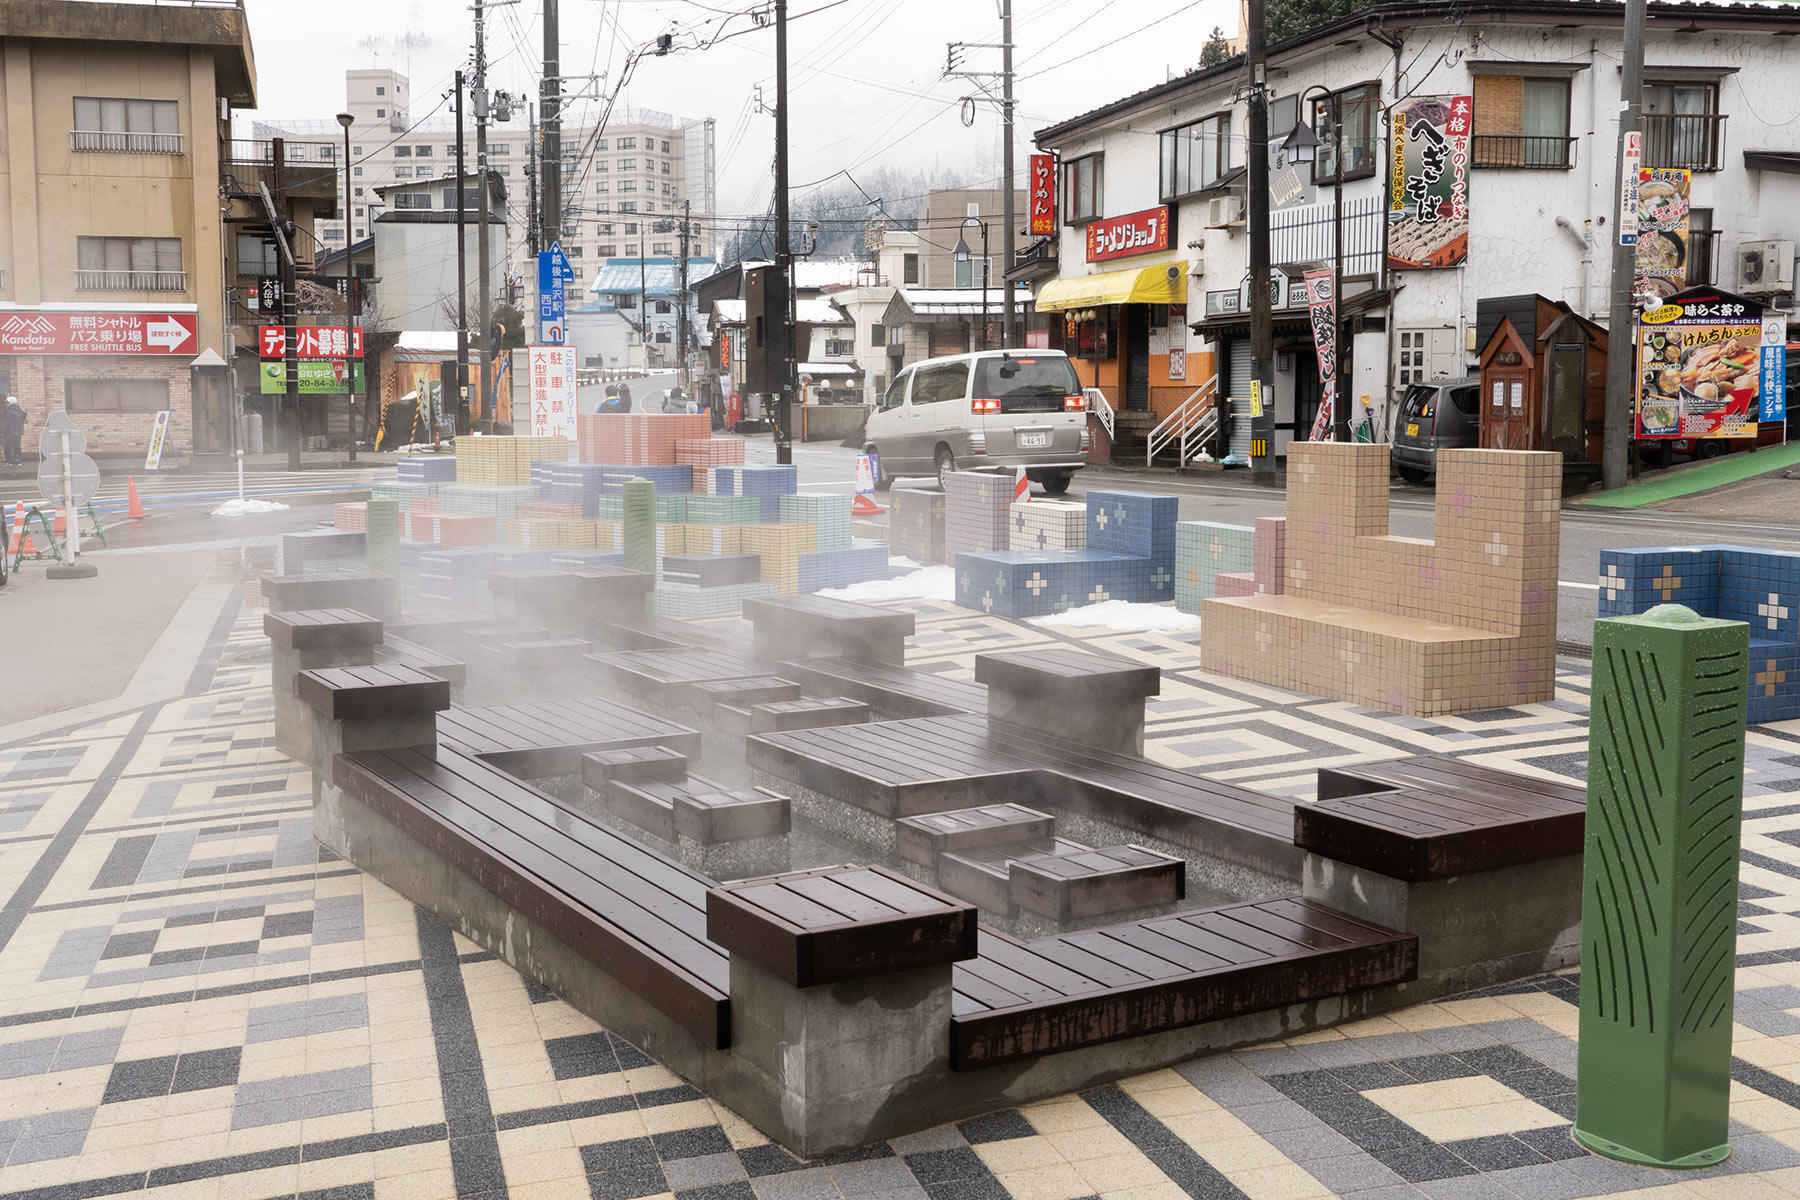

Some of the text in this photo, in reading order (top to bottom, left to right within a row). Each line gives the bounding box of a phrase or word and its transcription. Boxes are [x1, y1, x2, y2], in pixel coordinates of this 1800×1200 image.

[1448, 100, 1469, 133] 本格
[1034, 158, 1050, 216] らーめん
[1406, 117, 1450, 223] へぎそば
[1451, 136, 1468, 221] 布のりつなぎ
[1033, 218, 1052, 233] 餃子
[1096, 217, 1158, 255] ラーメンショップ
[1160, 209, 1168, 248] うまい
[551, 254, 563, 312] 越後湯沢駅
[69, 316, 142, 329] 無料シャトル
[541, 294, 552, 317] 西口
[1684, 303, 1745, 317] 味らく茶や
[1, 334, 55, 345] Kandatsu
[70, 330, 143, 343] バス乗り場
[70, 343, 142, 351] FREE SHUTTLE BUS
[1682, 326, 1760, 347] けんちん うどん
[534, 352, 548, 436] 大型車進入禁止
[550, 352, 564, 436] 駐車禁止
[565, 350, 575, 425] この先ロータリー内
